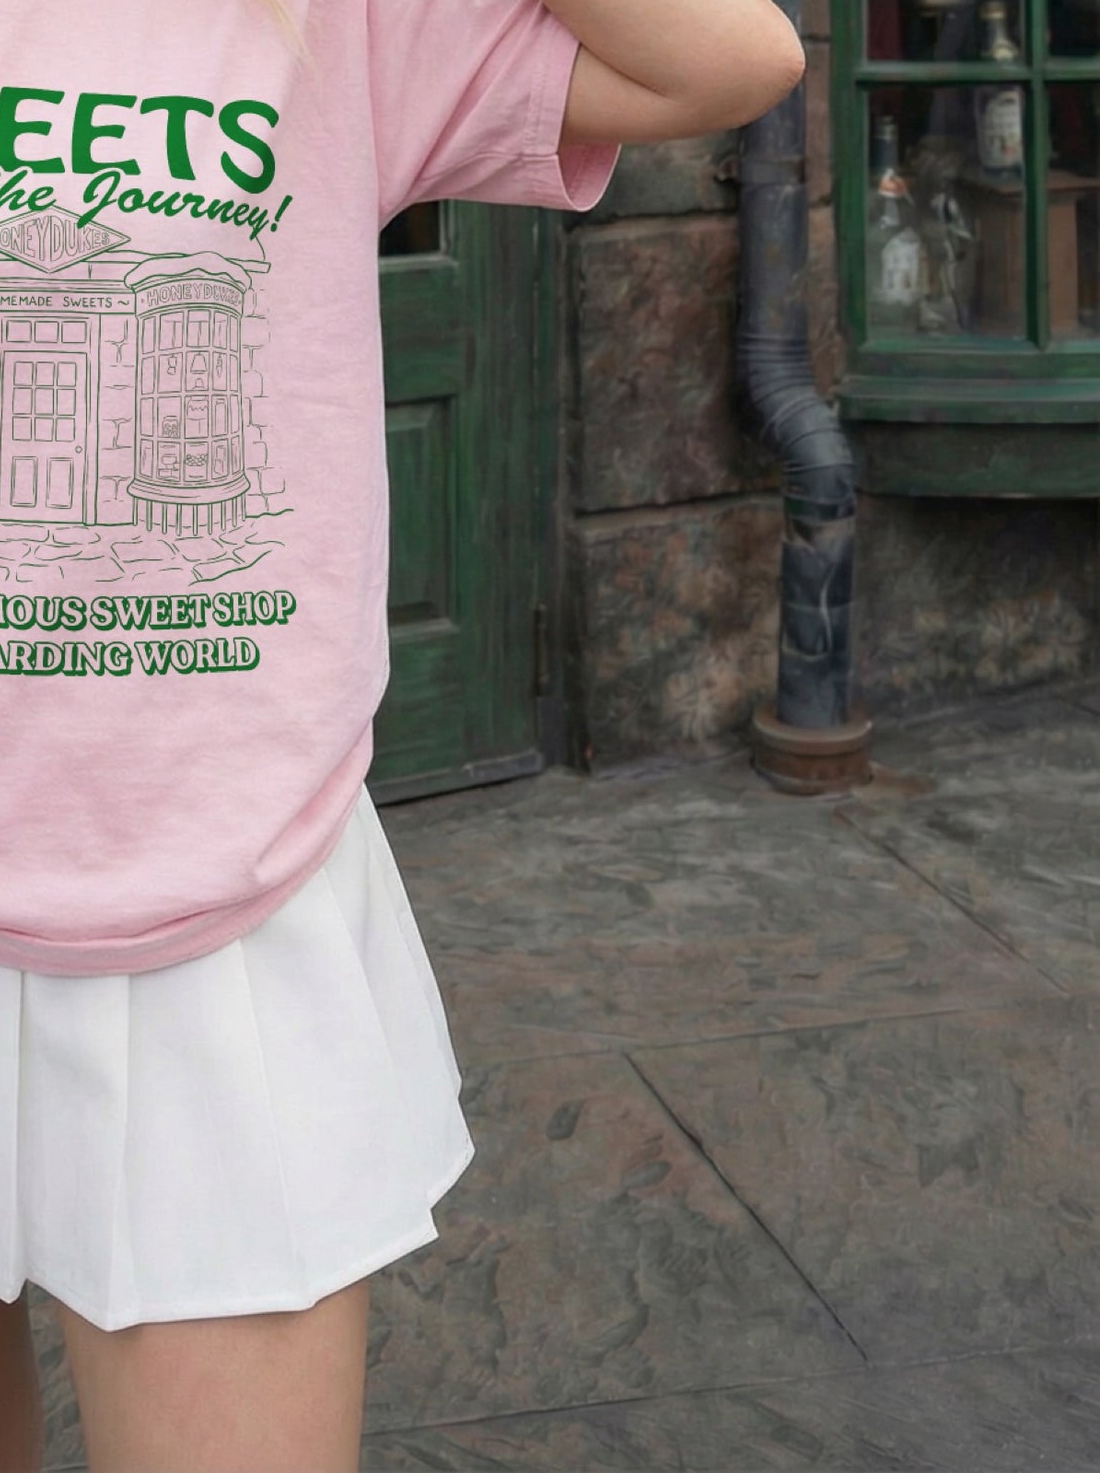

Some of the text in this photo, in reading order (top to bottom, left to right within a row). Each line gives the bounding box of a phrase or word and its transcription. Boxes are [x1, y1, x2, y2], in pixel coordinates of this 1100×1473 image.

[76, 170, 293, 241] Journey!
[63, 297, 113, 308] SWEETS
[90, 594, 212, 630] SWEET
[212, 590, 297, 627] SHOP
[134, 637, 260, 675] WORLD
